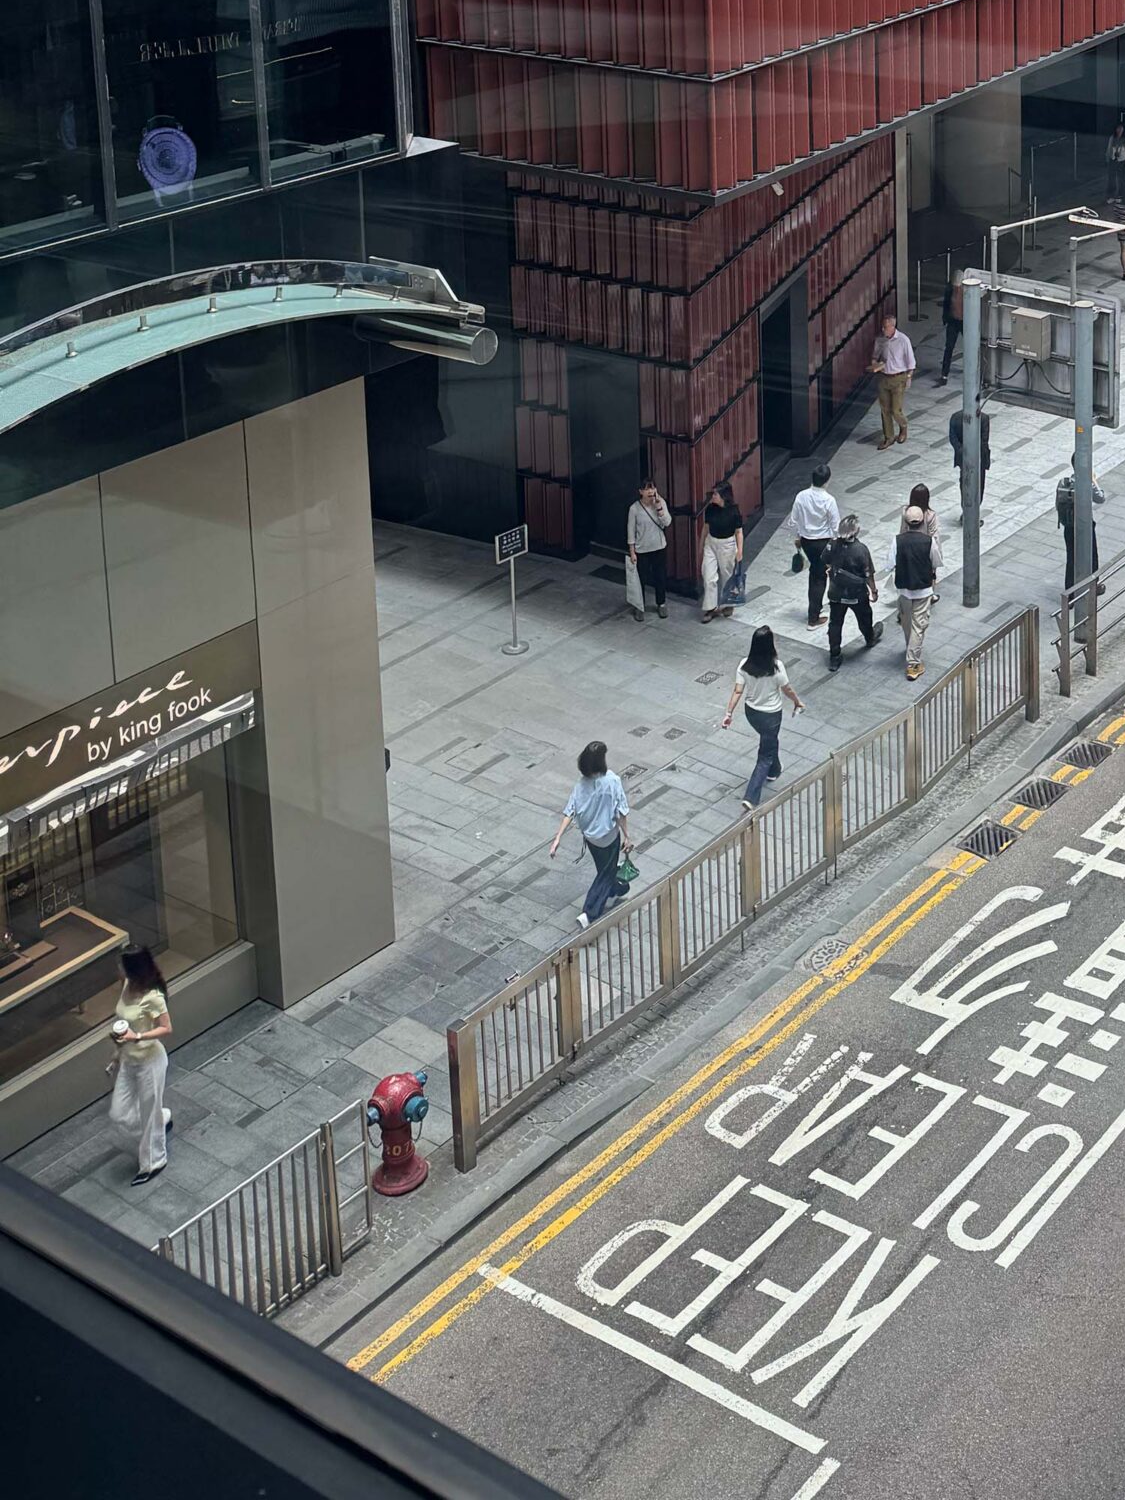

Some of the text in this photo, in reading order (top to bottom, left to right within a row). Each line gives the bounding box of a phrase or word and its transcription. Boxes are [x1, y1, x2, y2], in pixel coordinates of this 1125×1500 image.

[87, 688, 212, 762] by king fook
[704, 1033, 1085, 1253] CLEAR
[576, 1175, 941, 1408] KEEP
